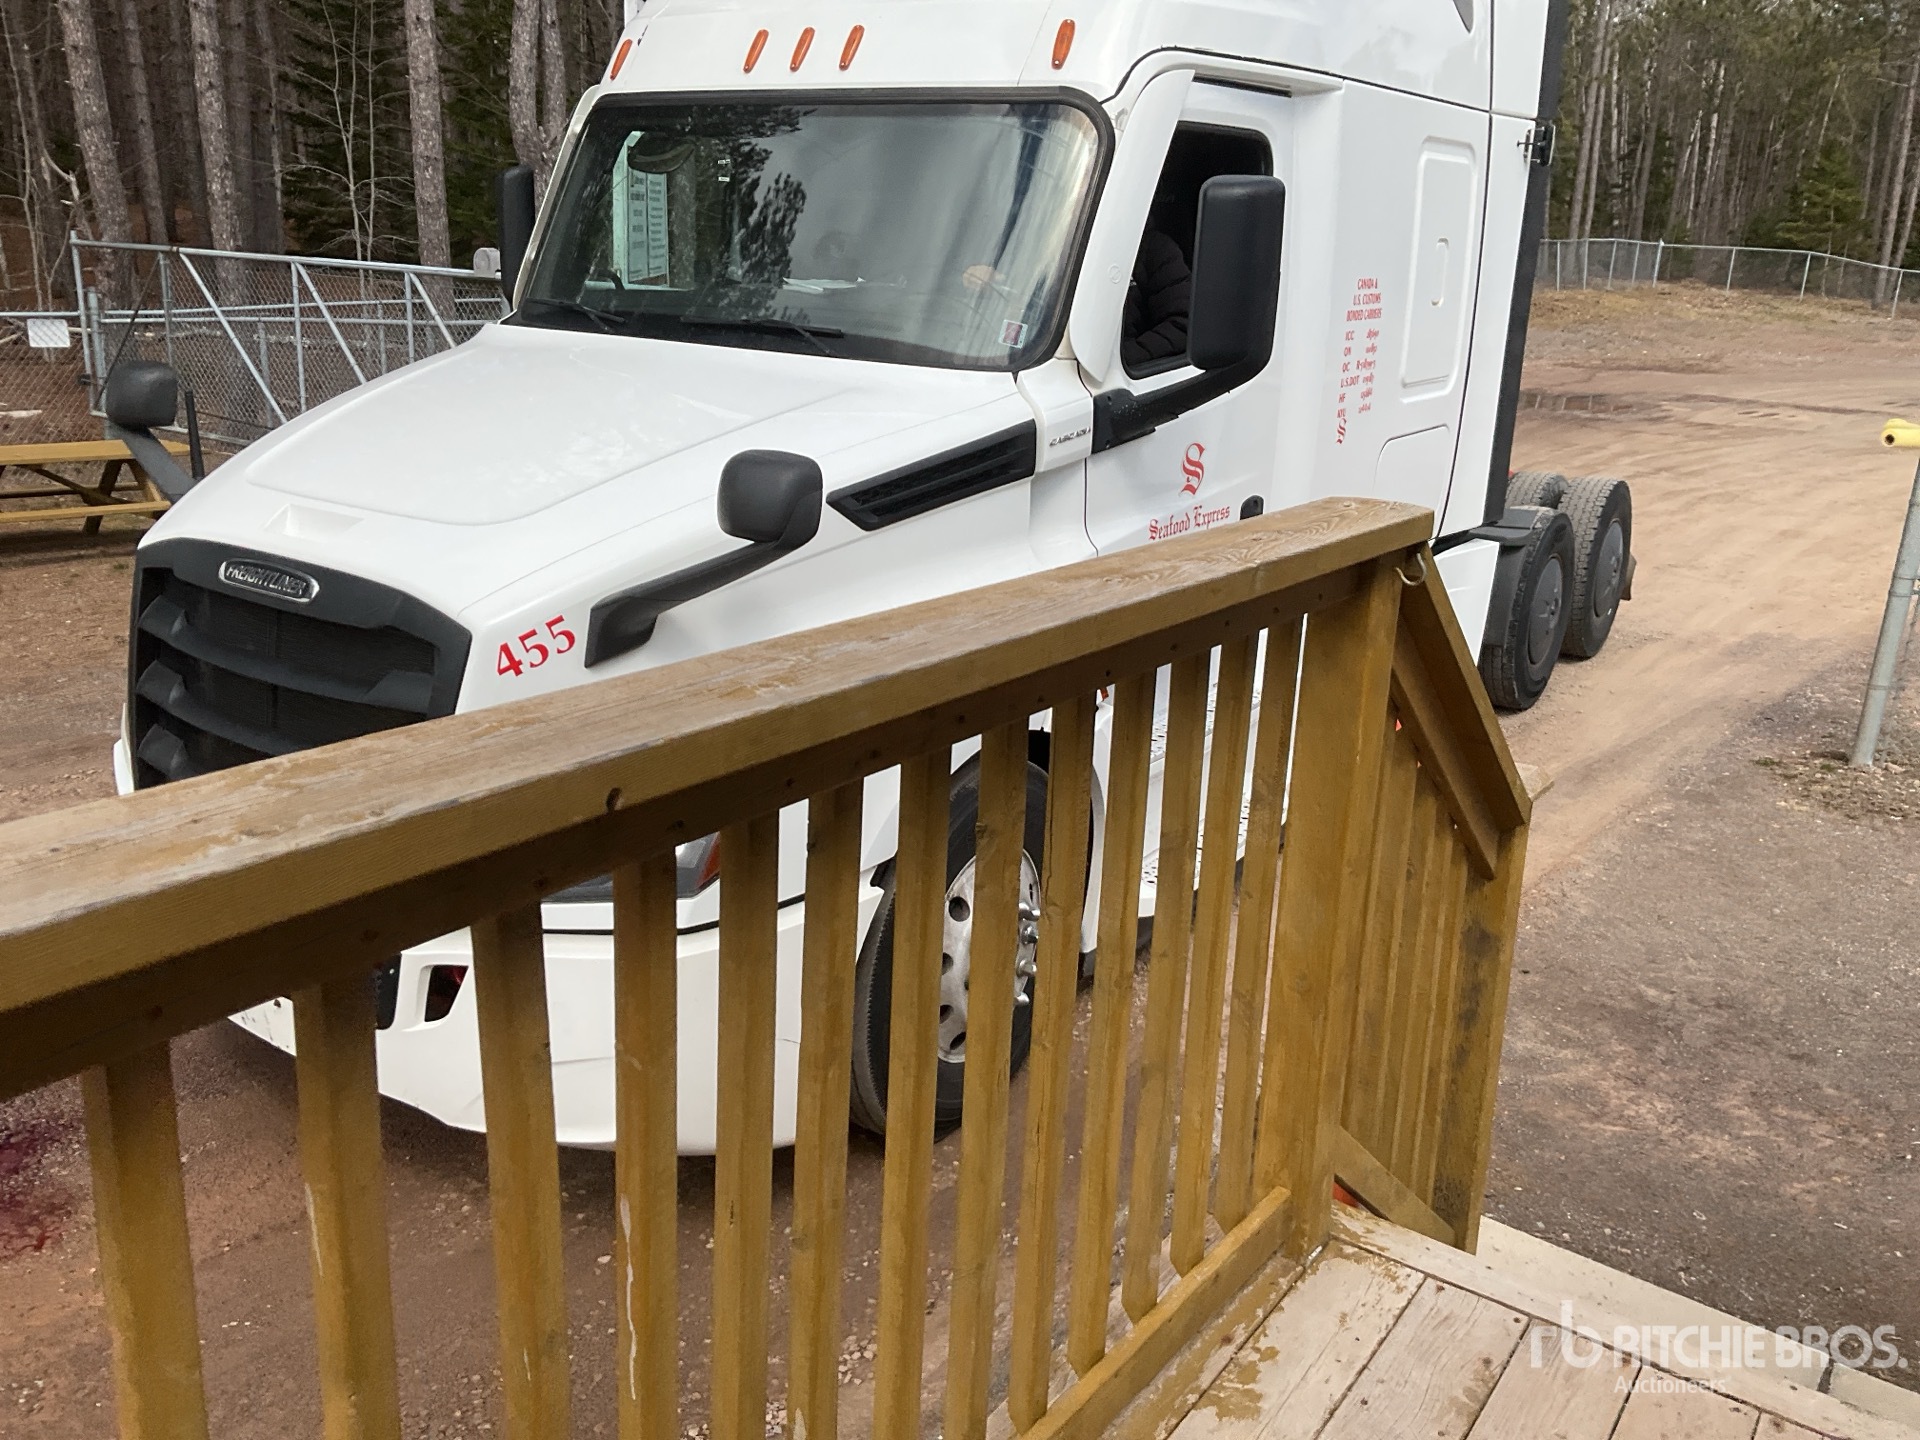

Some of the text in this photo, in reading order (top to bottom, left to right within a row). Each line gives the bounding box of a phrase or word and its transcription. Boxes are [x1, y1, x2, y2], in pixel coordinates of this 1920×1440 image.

[1357, 278, 1374, 290] CANADA
[1362, 293, 1382, 305] CUSTOMS
[1346, 308, 1383, 321] BONDED CARRIERS
[1149, 505, 1231, 540] Seafood Express
[226, 565, 307, 595] FREIGHTLINER
[496, 614, 576, 677] 455
